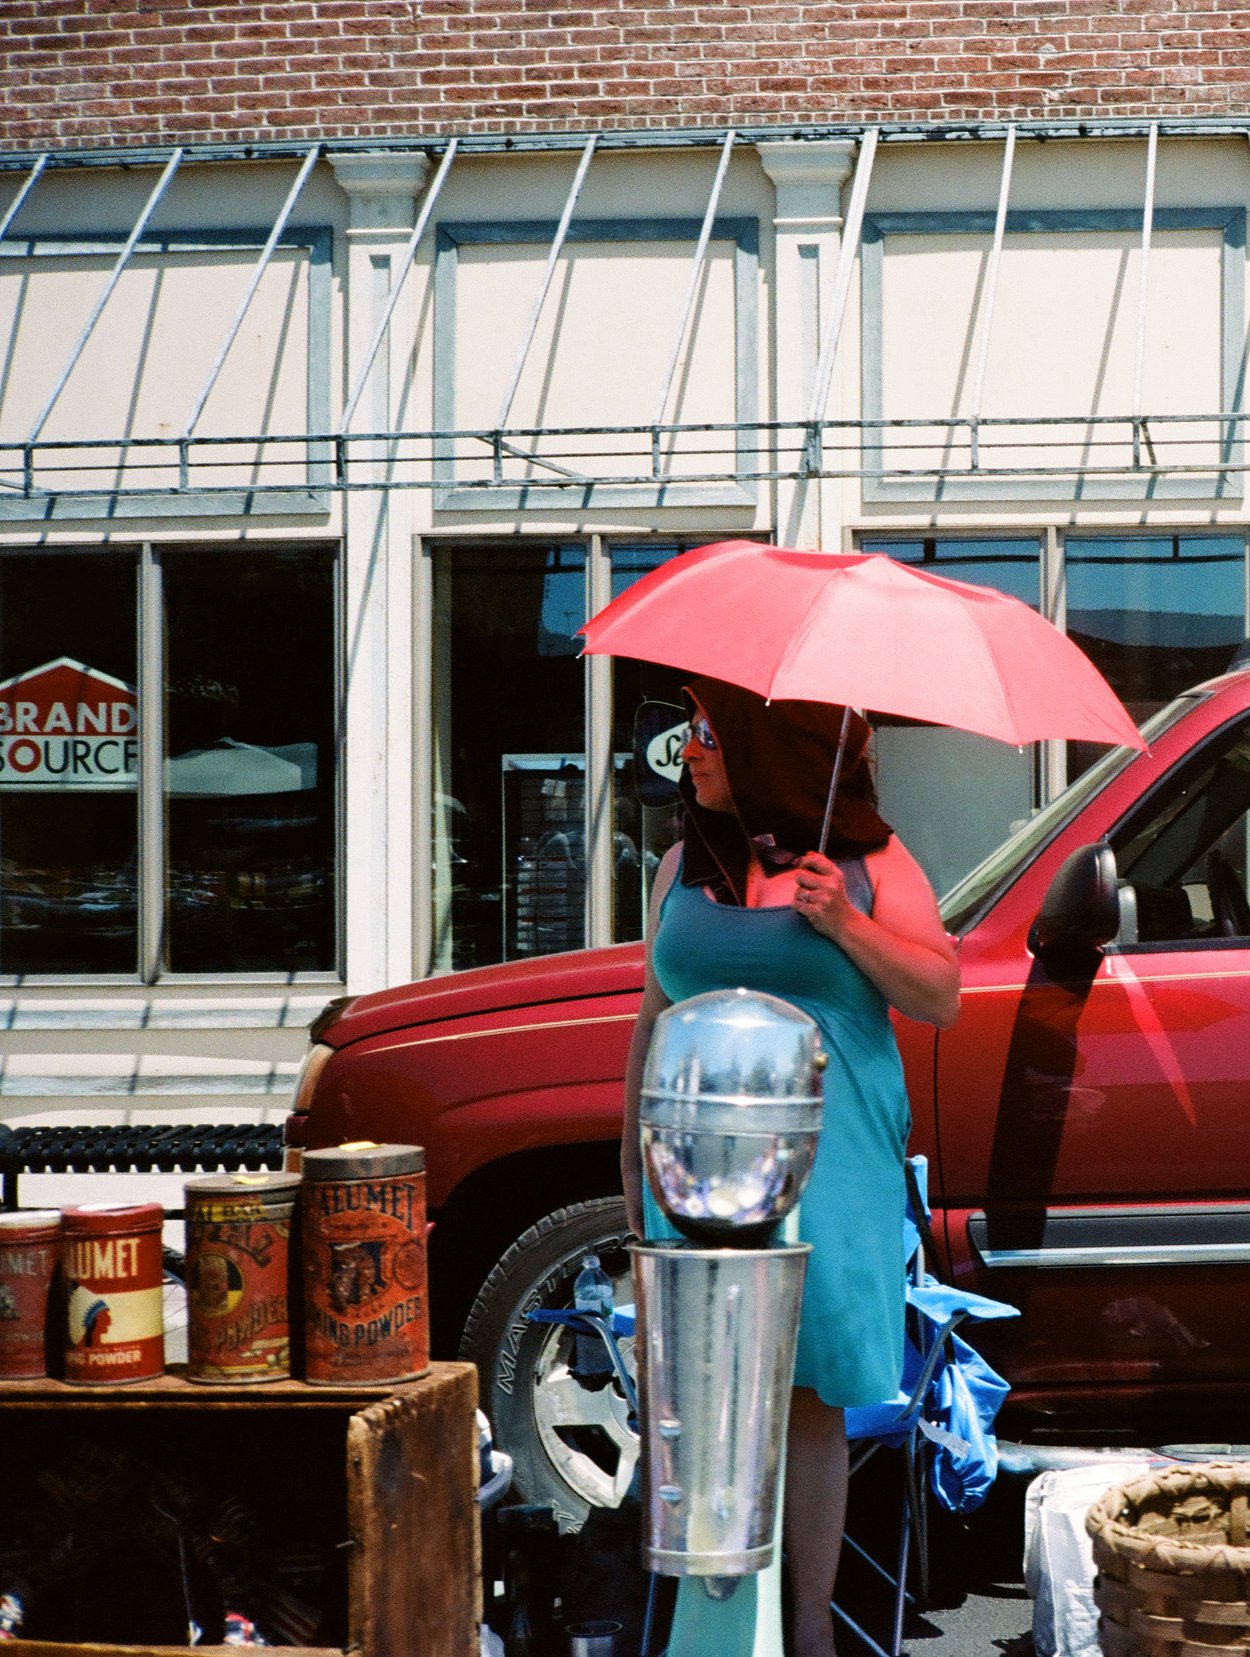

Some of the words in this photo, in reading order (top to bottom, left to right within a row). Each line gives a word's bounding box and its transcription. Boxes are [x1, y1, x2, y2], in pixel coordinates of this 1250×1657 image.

[0, 702, 137, 733] BRAND
[354, 1296, 422, 1347] POWDER
[88, 1350, 142, 1367] POWDER
